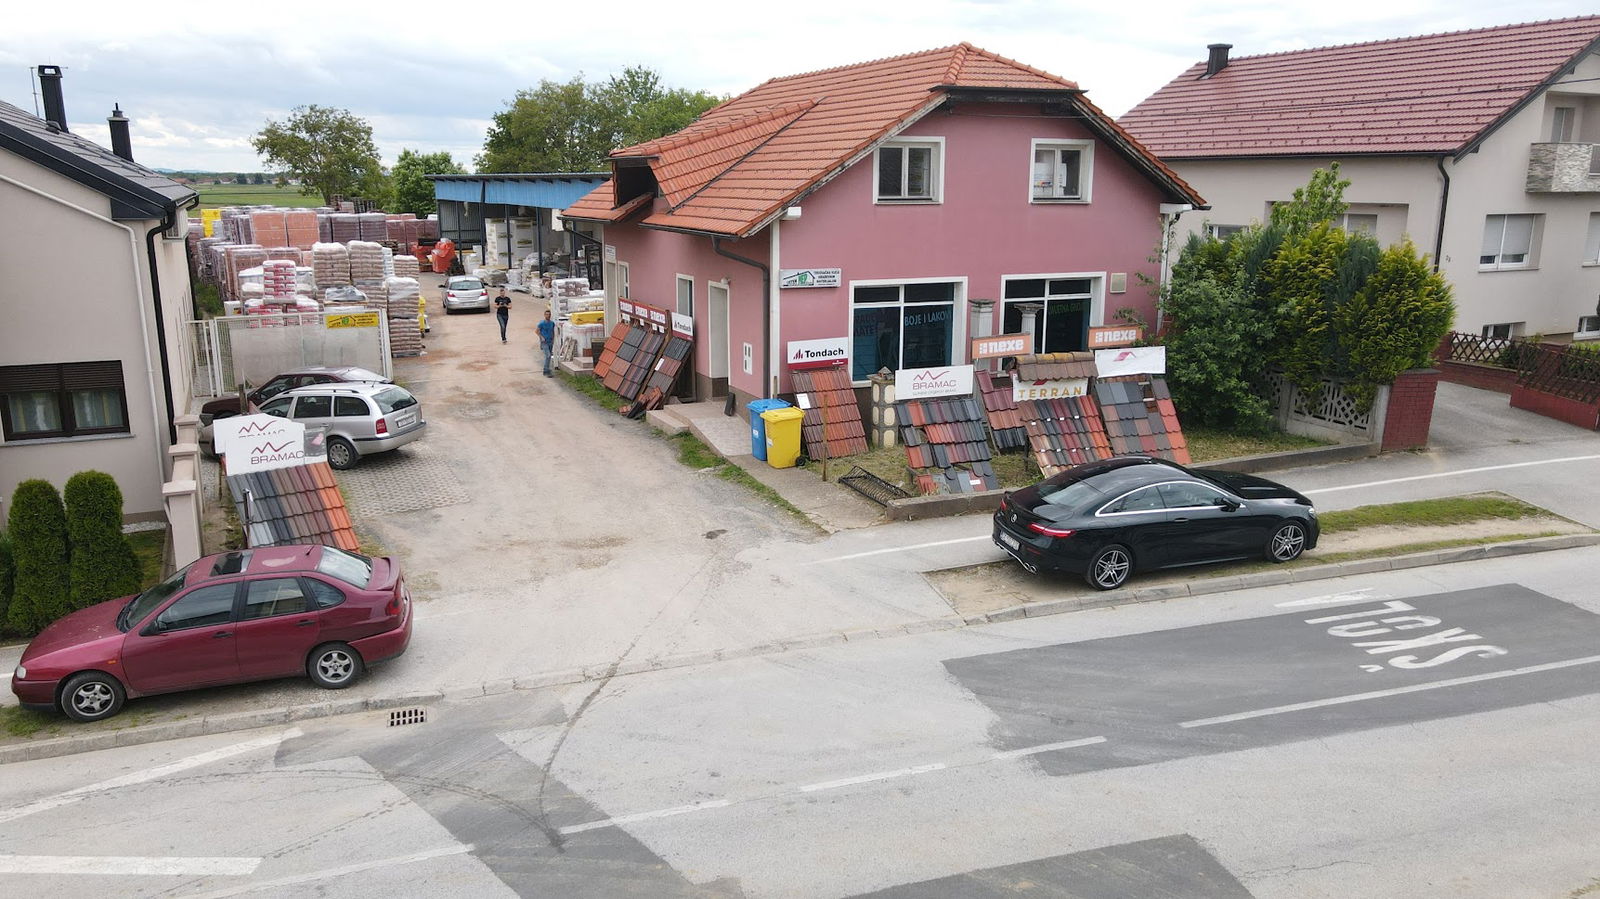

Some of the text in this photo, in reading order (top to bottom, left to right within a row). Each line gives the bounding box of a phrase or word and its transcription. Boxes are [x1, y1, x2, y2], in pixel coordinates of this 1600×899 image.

[904, 315, 922, 327] BOJE
[1104, 329, 1136, 343] nexe
[989, 339, 1024, 353] nexe
[805, 348, 844, 358] Tondach
[912, 379, 957, 390] BRAMAC
[1018, 386, 1083, 398] TERRAN
[250, 450, 305, 465] BRAMAC
